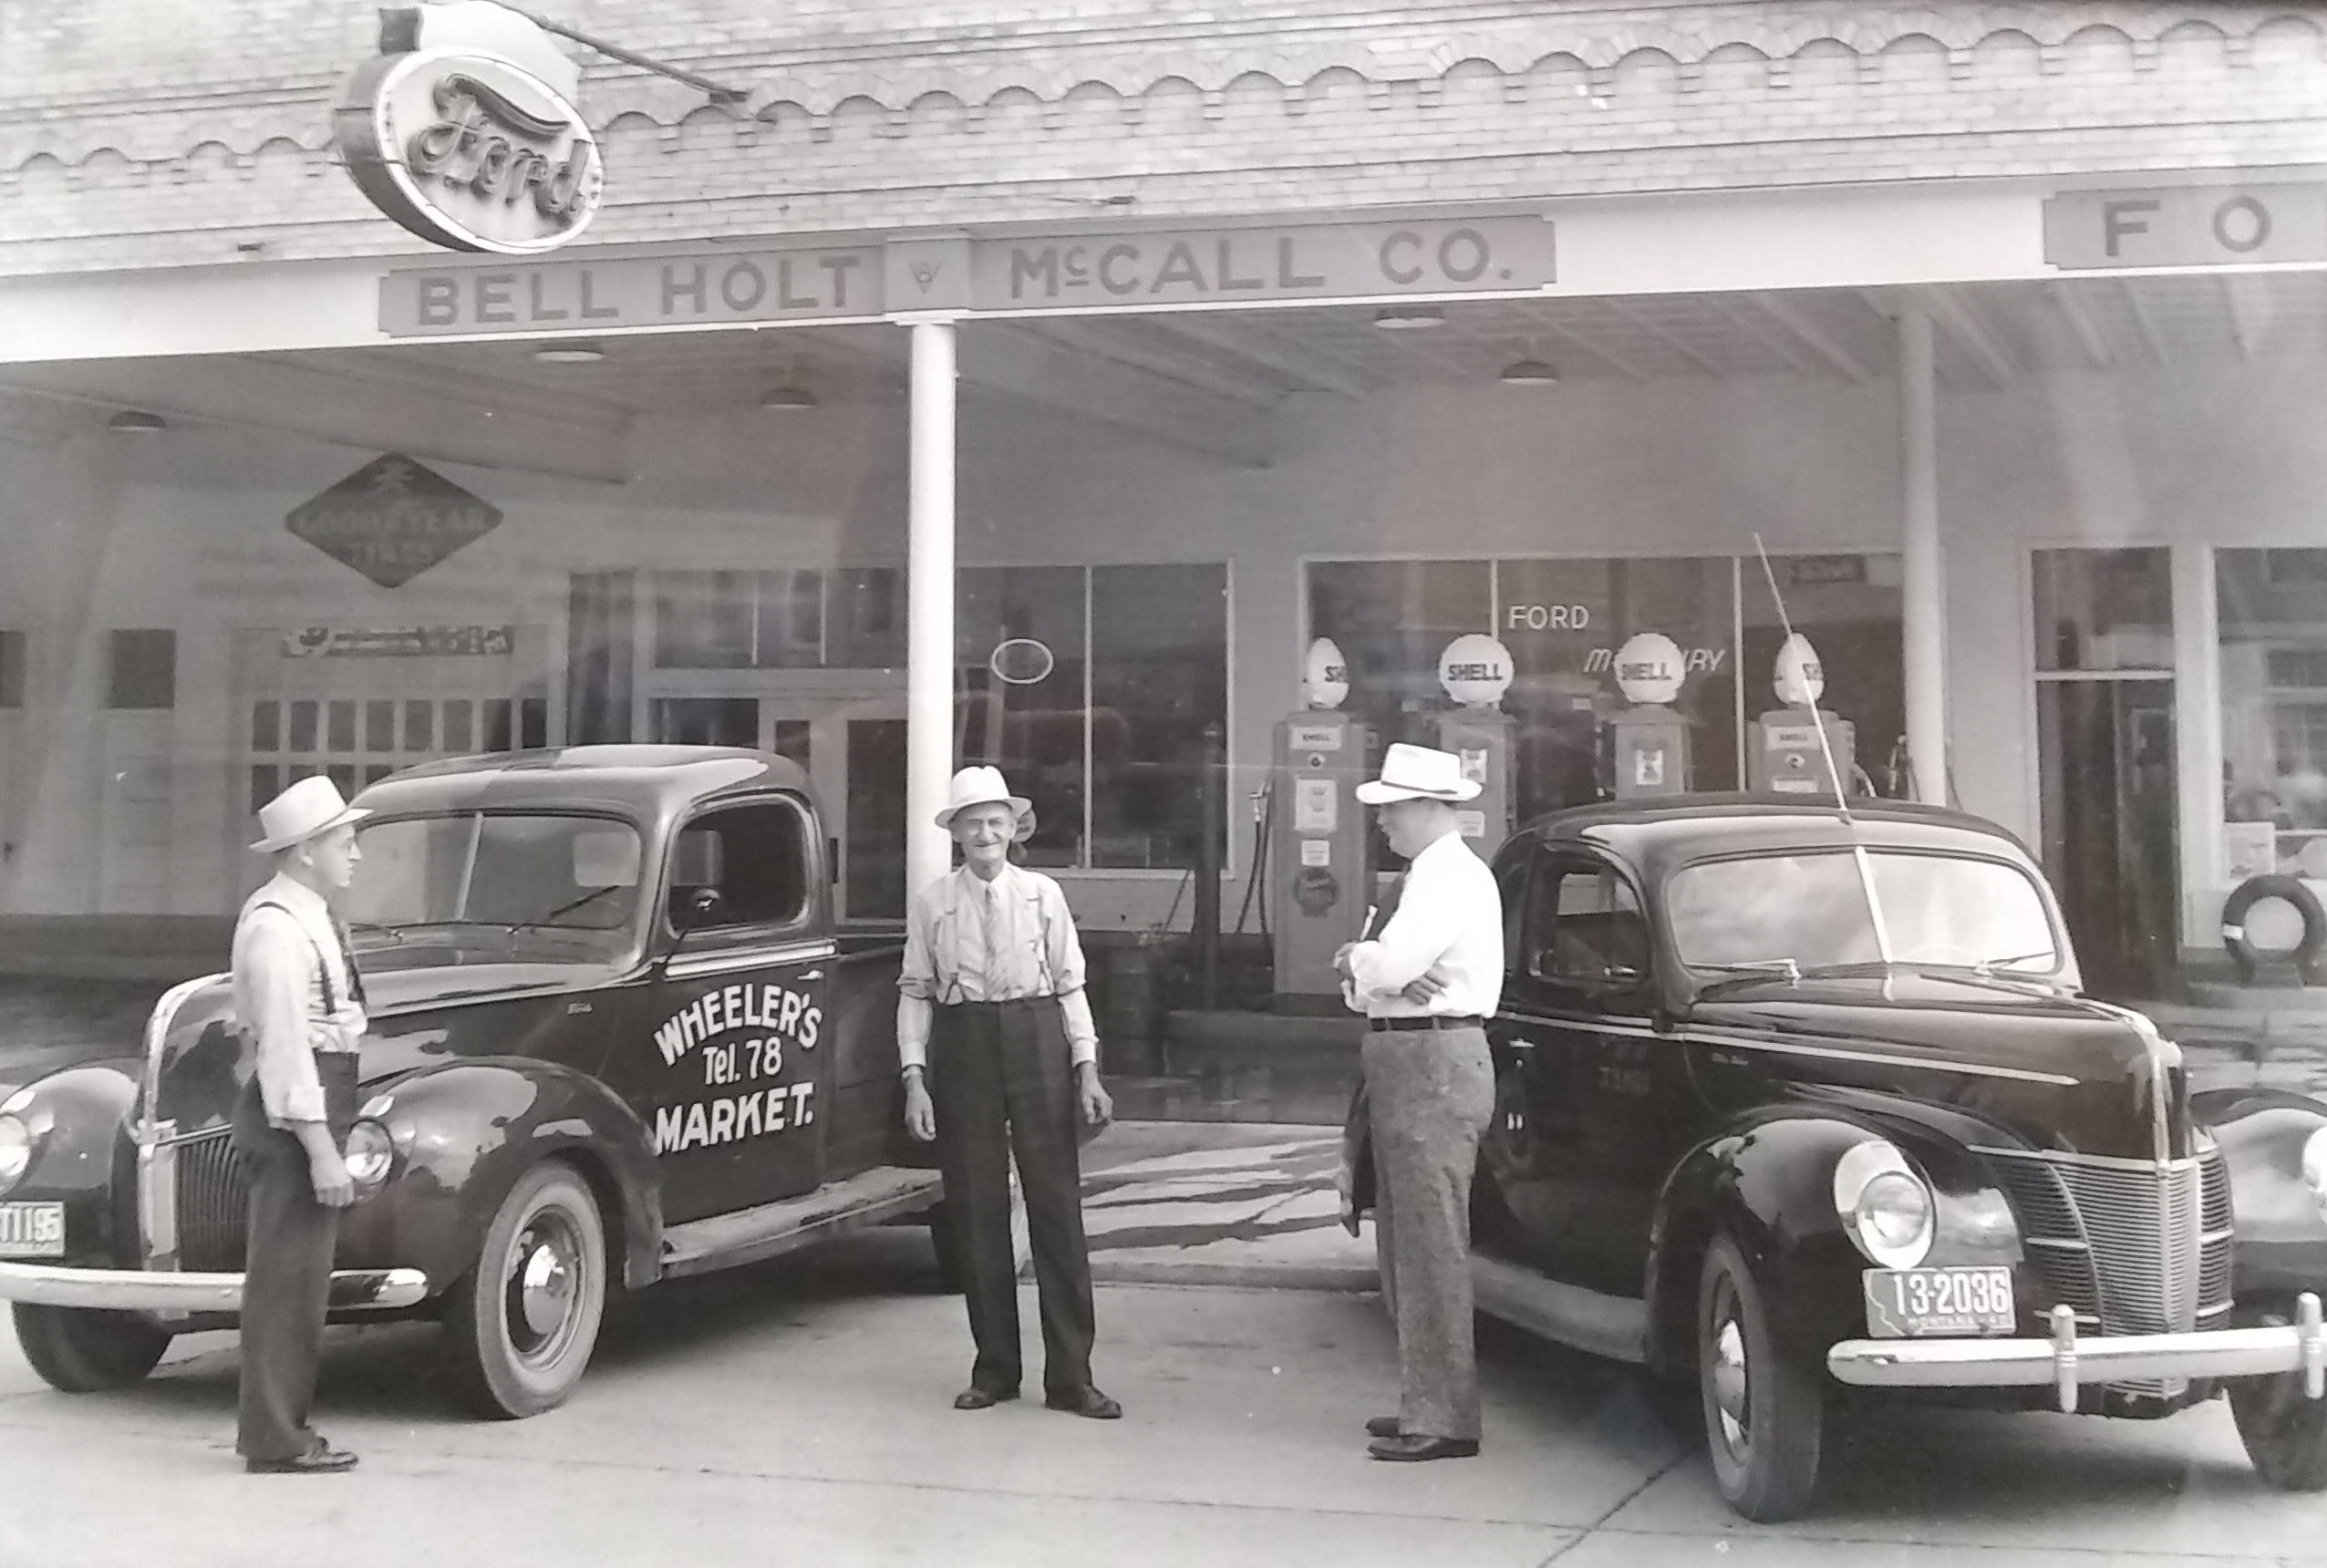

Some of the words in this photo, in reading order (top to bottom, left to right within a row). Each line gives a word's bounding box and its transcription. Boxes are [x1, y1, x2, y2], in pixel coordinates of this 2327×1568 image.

[408, 73, 593, 226] Ford
[419, 273, 619, 325] BELL
[661, 254, 860, 315] HOLT
[1009, 235, 1327, 300] McCALL
[1379, 227, 1515, 285] CO.
[1508, 604, 1589, 629] FORD
[1448, 664, 1503, 681] SHELL
[653, 983, 822, 1067] WHEELER'S
[703, 1043, 741, 1085] Tel.
[745, 1036, 782, 1079] 78
[656, 1081, 815, 1156] MARKET.
[1893, 1272, 2009, 1315] 13-2036
